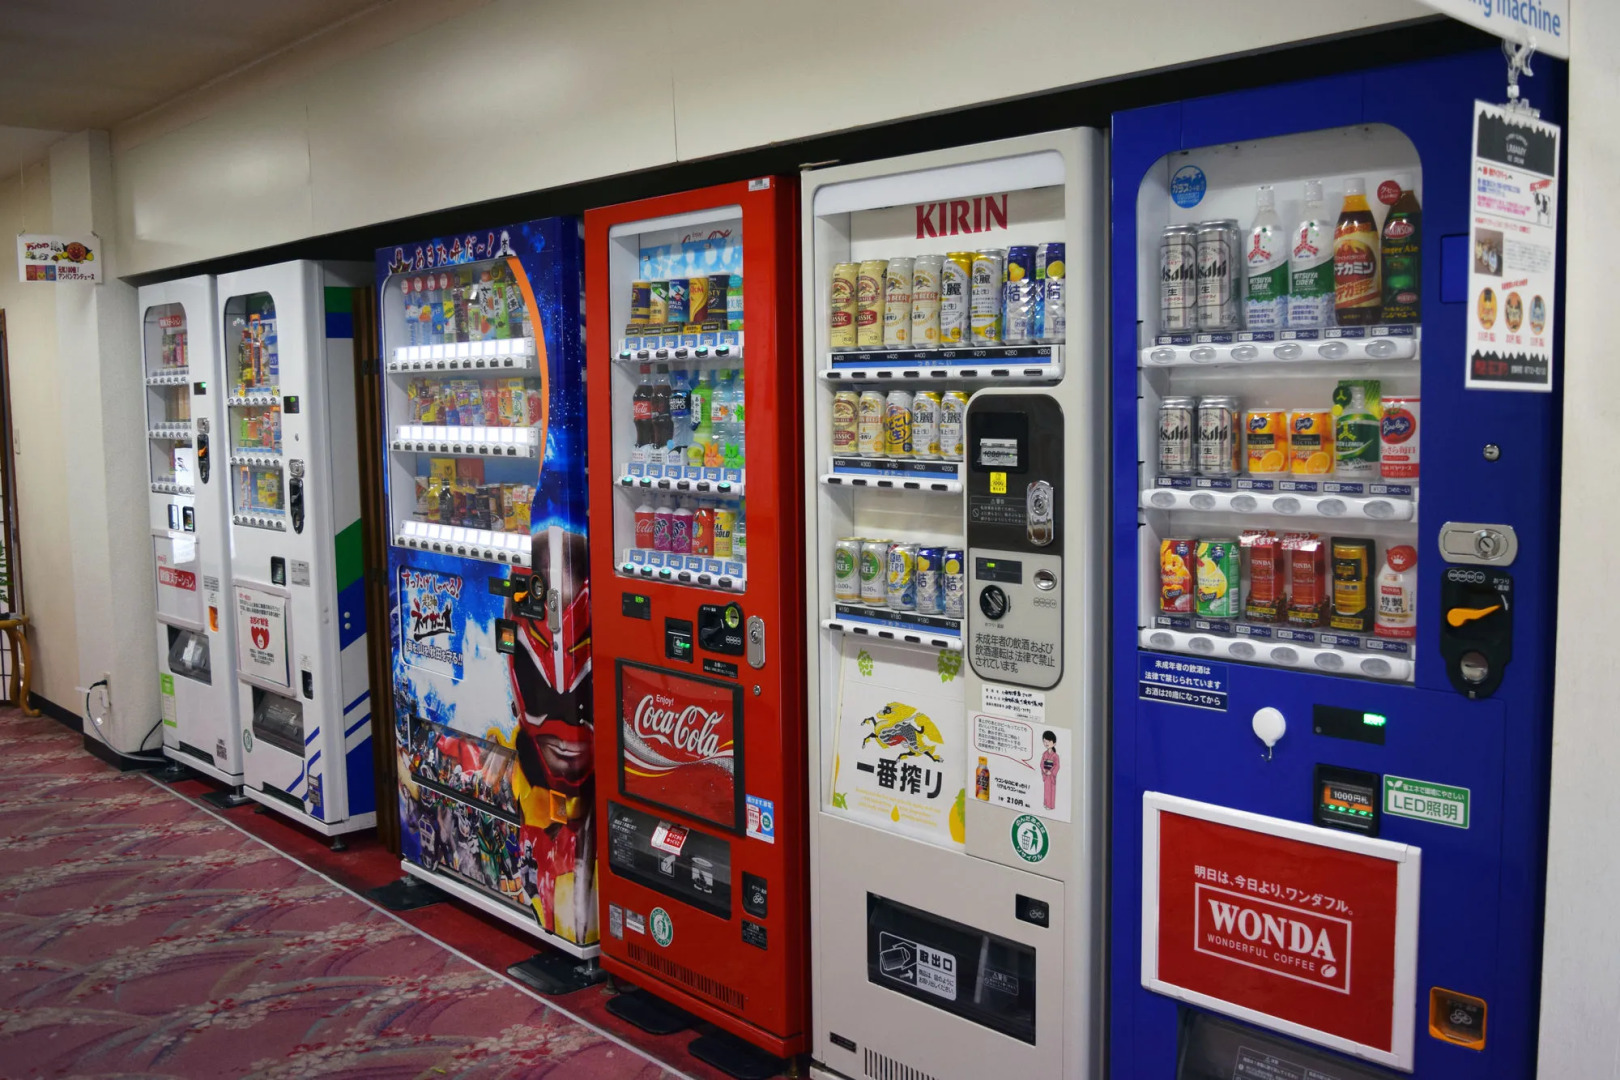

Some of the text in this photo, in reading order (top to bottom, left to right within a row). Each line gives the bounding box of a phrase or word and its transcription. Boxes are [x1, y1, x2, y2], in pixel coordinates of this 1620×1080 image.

[915, 194, 1008, 240] KIRIN
[975, 632, 1054, 655] 未成年者の飲酒および
[975, 645, 1056, 668] 飲酒運転は法律で禁止
[975, 657, 1019, 674] されています。
[1155, 660, 1211, 675] 未成年者の飲酒は
[1144, 671, 1222, 690] 法律で禁じられています
[655, 693, 674, 707] Enjoy!
[1144, 687, 1221, 706] お酒は20歳になってから
[634, 694, 726, 757] Coca-Cola
[856, 757, 943, 799] 一番搾り
[1006, 796, 1024, 807] 210円
[1333, 790, 1369, 805] 1000円札
[1393, 794, 1458, 821] LED照明
[1194, 864, 1353, 916] 明日は、今日より、ワンダフル。
[1208, 898, 1336, 962] WONDA
[919, 949, 953, 972] 取出口
[1207, 933, 1315, 971] WONDERFUL COFFEE
